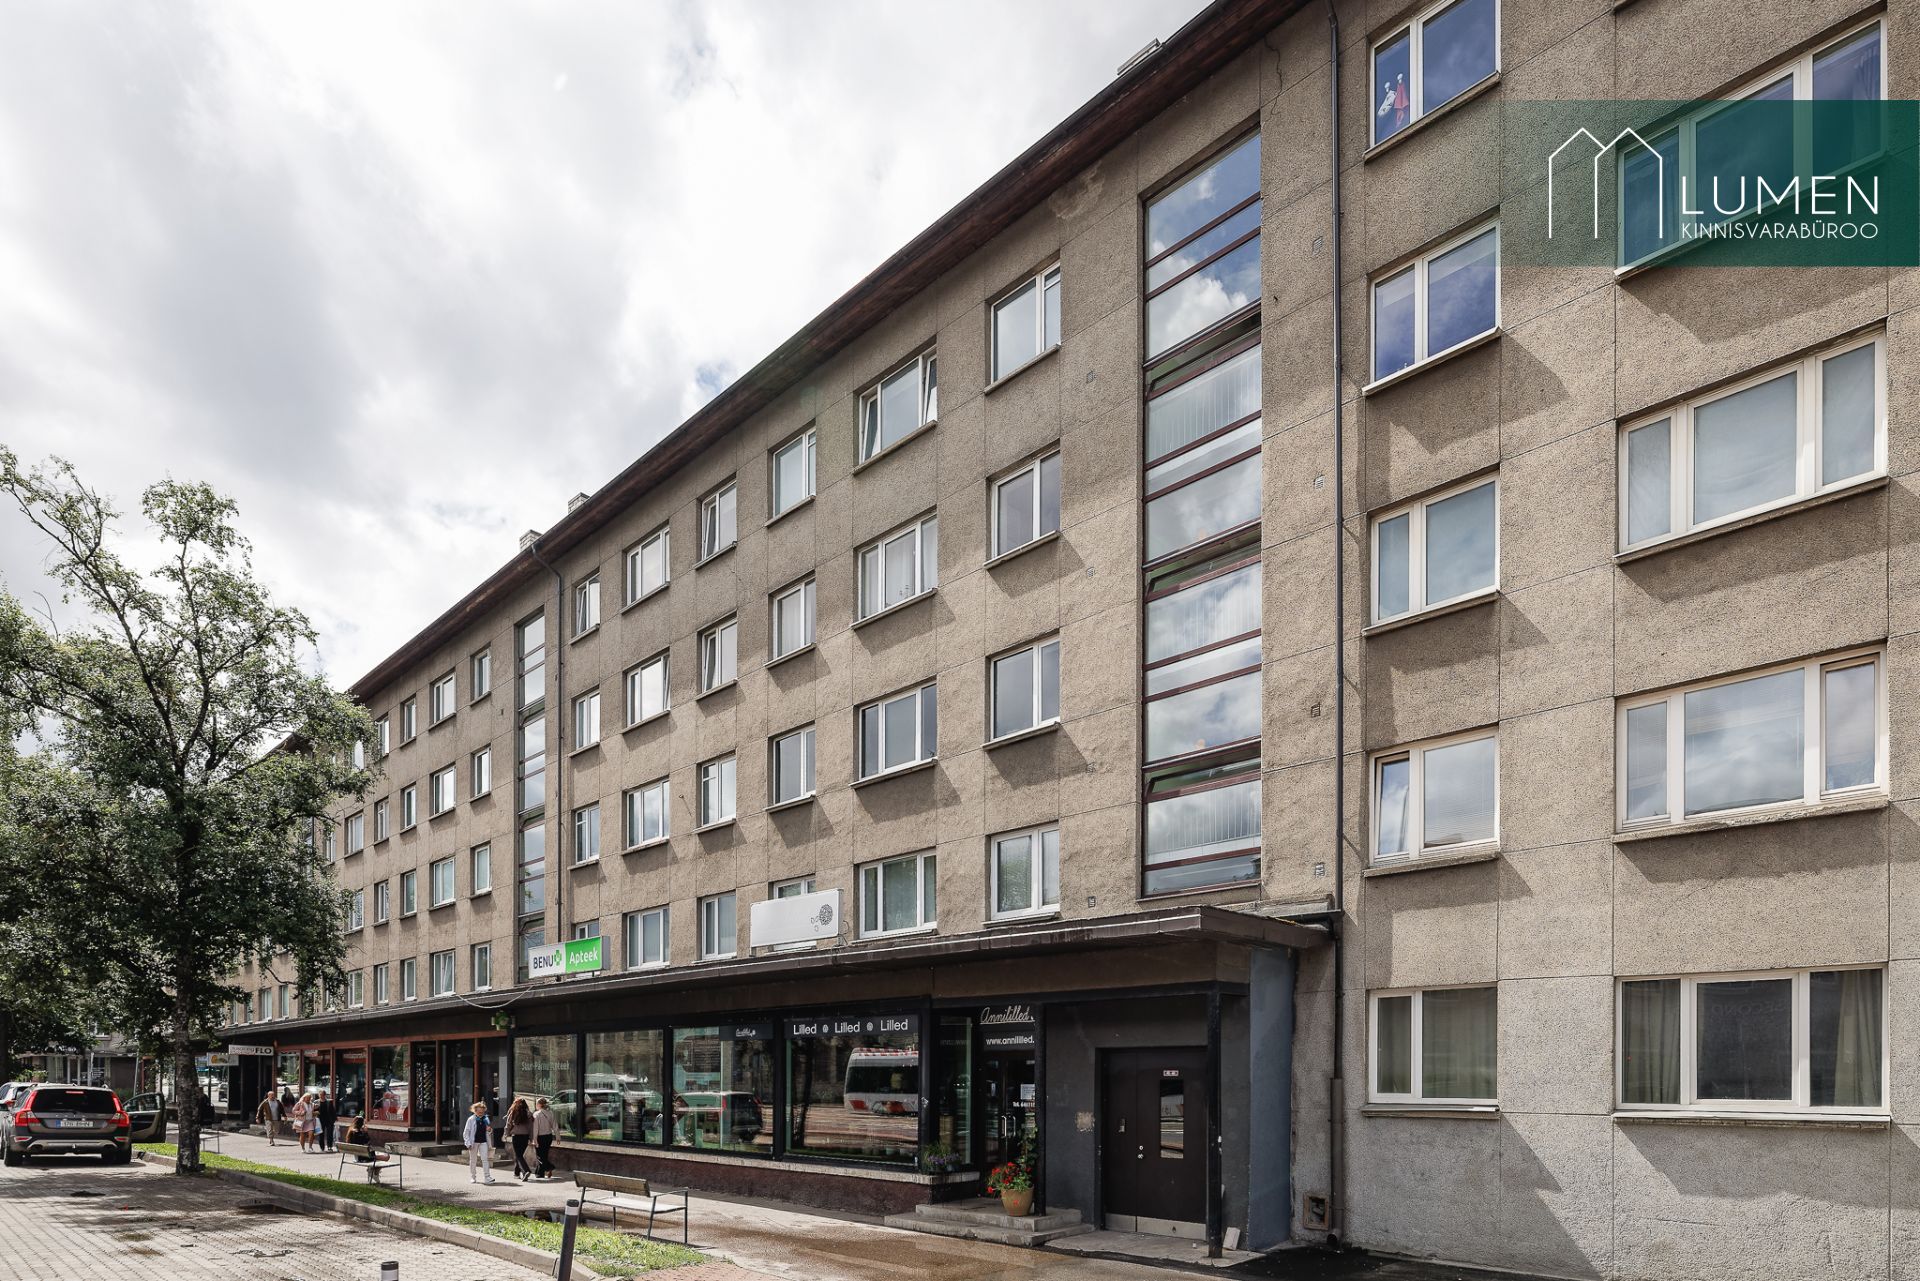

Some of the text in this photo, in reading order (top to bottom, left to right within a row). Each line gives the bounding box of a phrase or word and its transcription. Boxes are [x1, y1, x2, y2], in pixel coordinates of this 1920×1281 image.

[533, 946, 599, 970] BENU Apteek
[793, 1018, 909, 1036] Lilled Lilled Lilled
[255, 1047, 272, 1055] FLO
